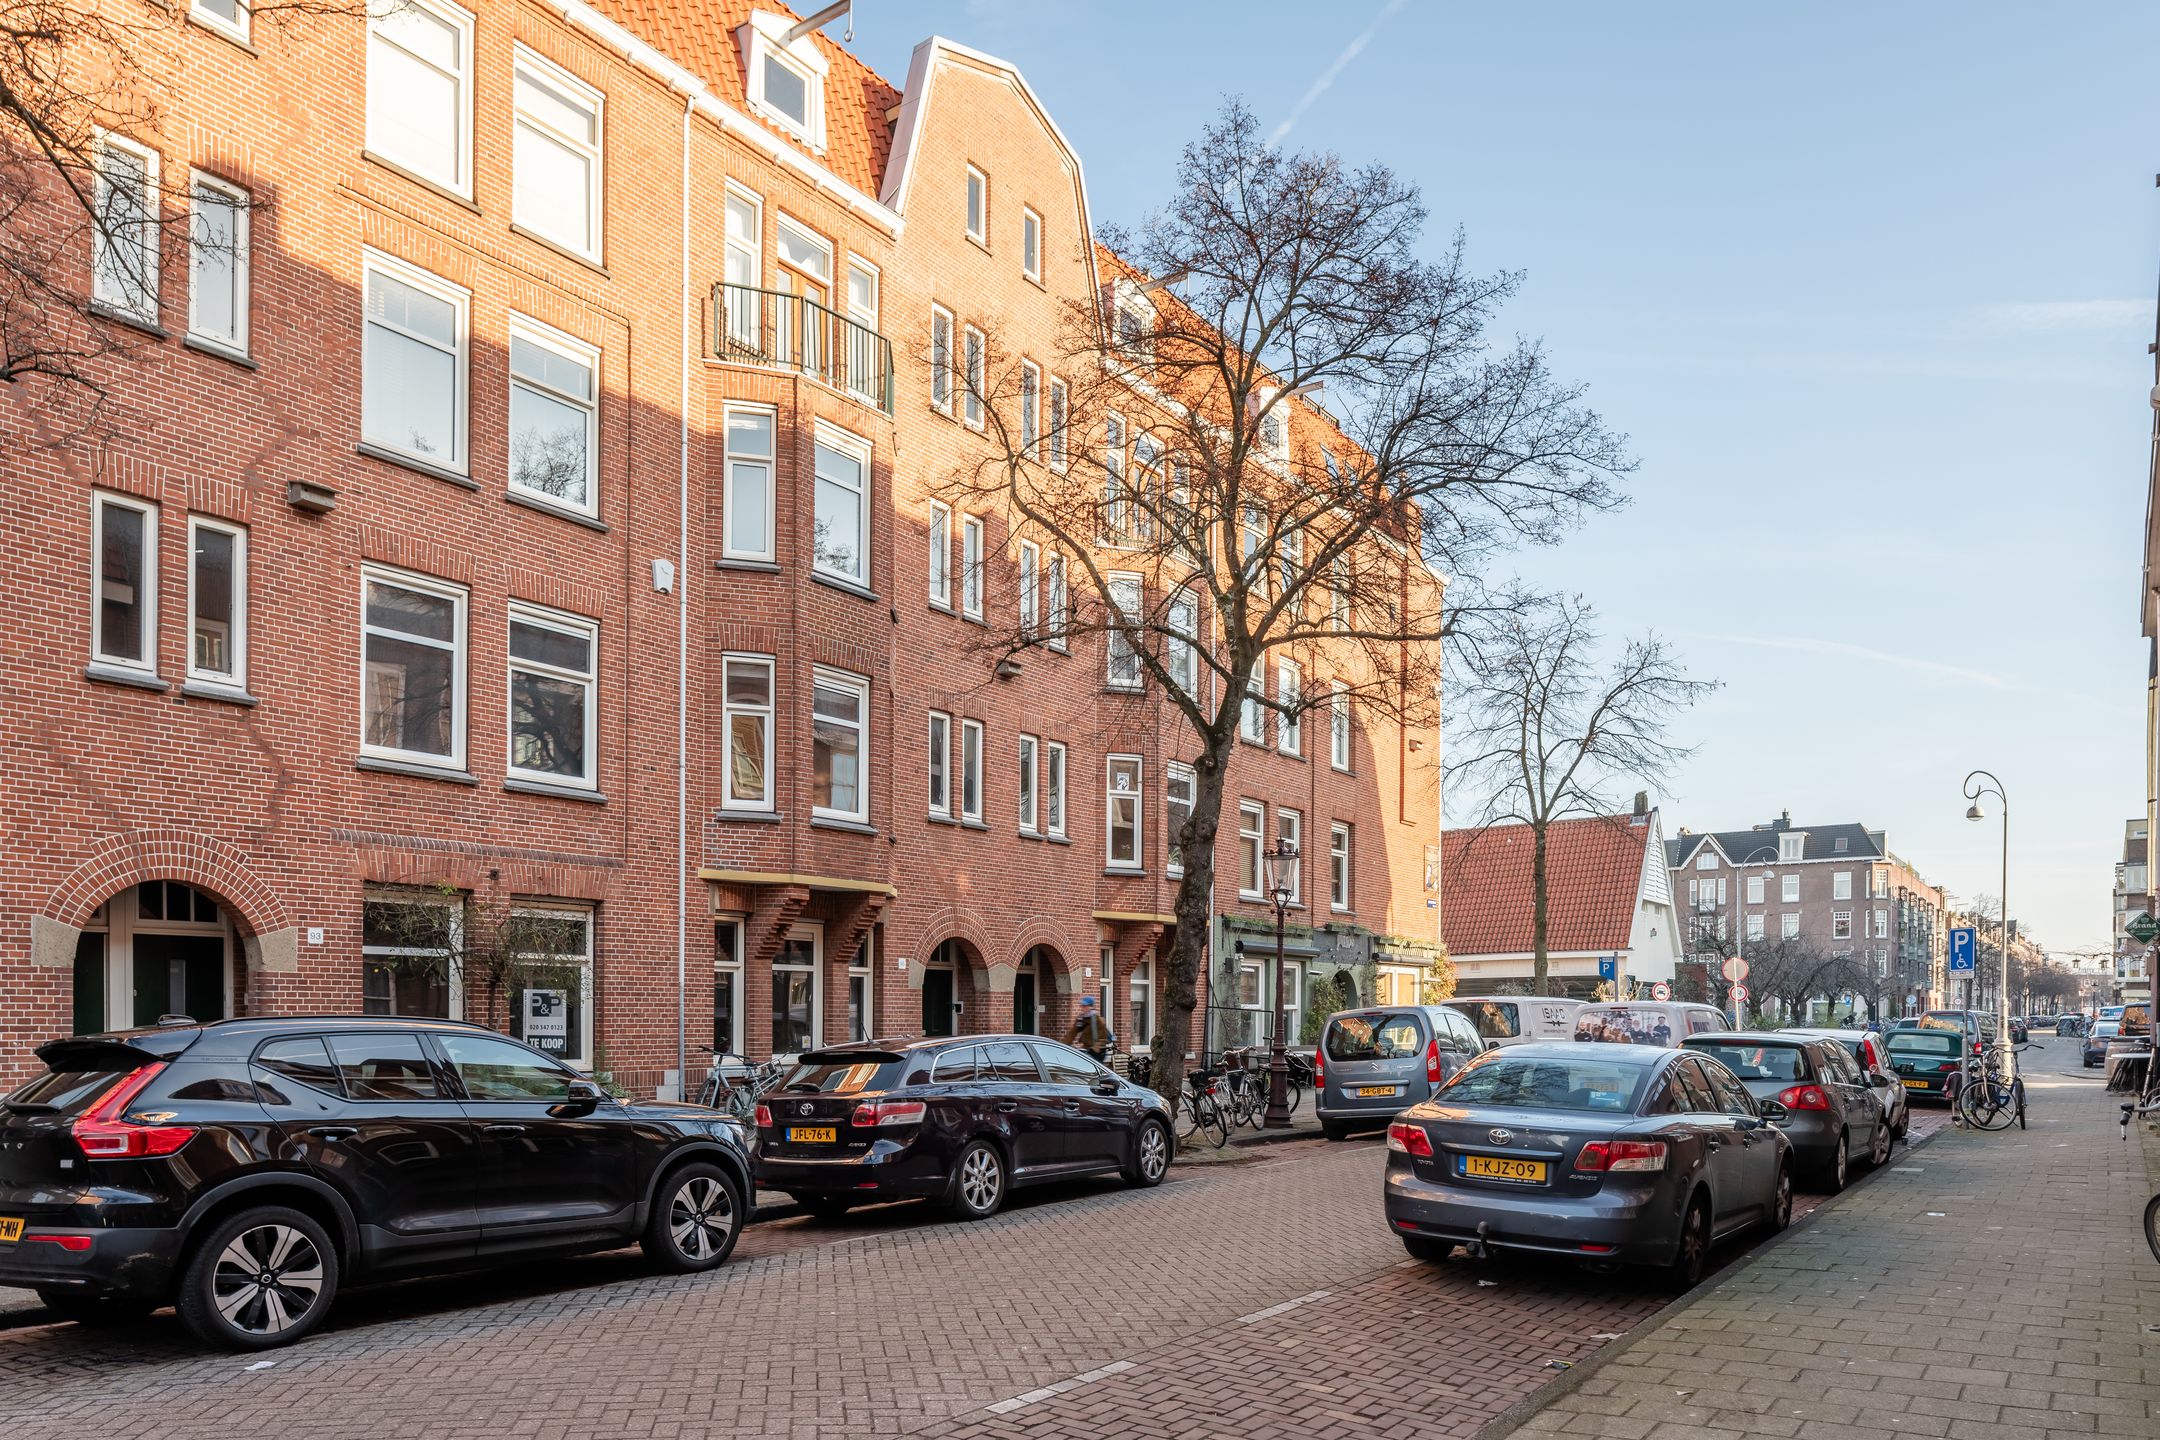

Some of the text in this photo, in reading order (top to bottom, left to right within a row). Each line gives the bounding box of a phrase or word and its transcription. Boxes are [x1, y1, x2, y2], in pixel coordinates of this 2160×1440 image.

[2132, 921, 2156, 929] Brand
[310, 932, 321, 940] 93
[1954, 931, 1969, 953] P
[1603, 963, 1610, 974] P
[1542, 1007, 1565, 1019] ISAAC
[530, 1038, 563, 1049] TE KOOP
[1361, 1087, 1392, 1095] 34-GBT-4
[794, 1128, 831, 1140] JFL-76-K
[1473, 1159, 1536, 1177] 1-KJZ-09
